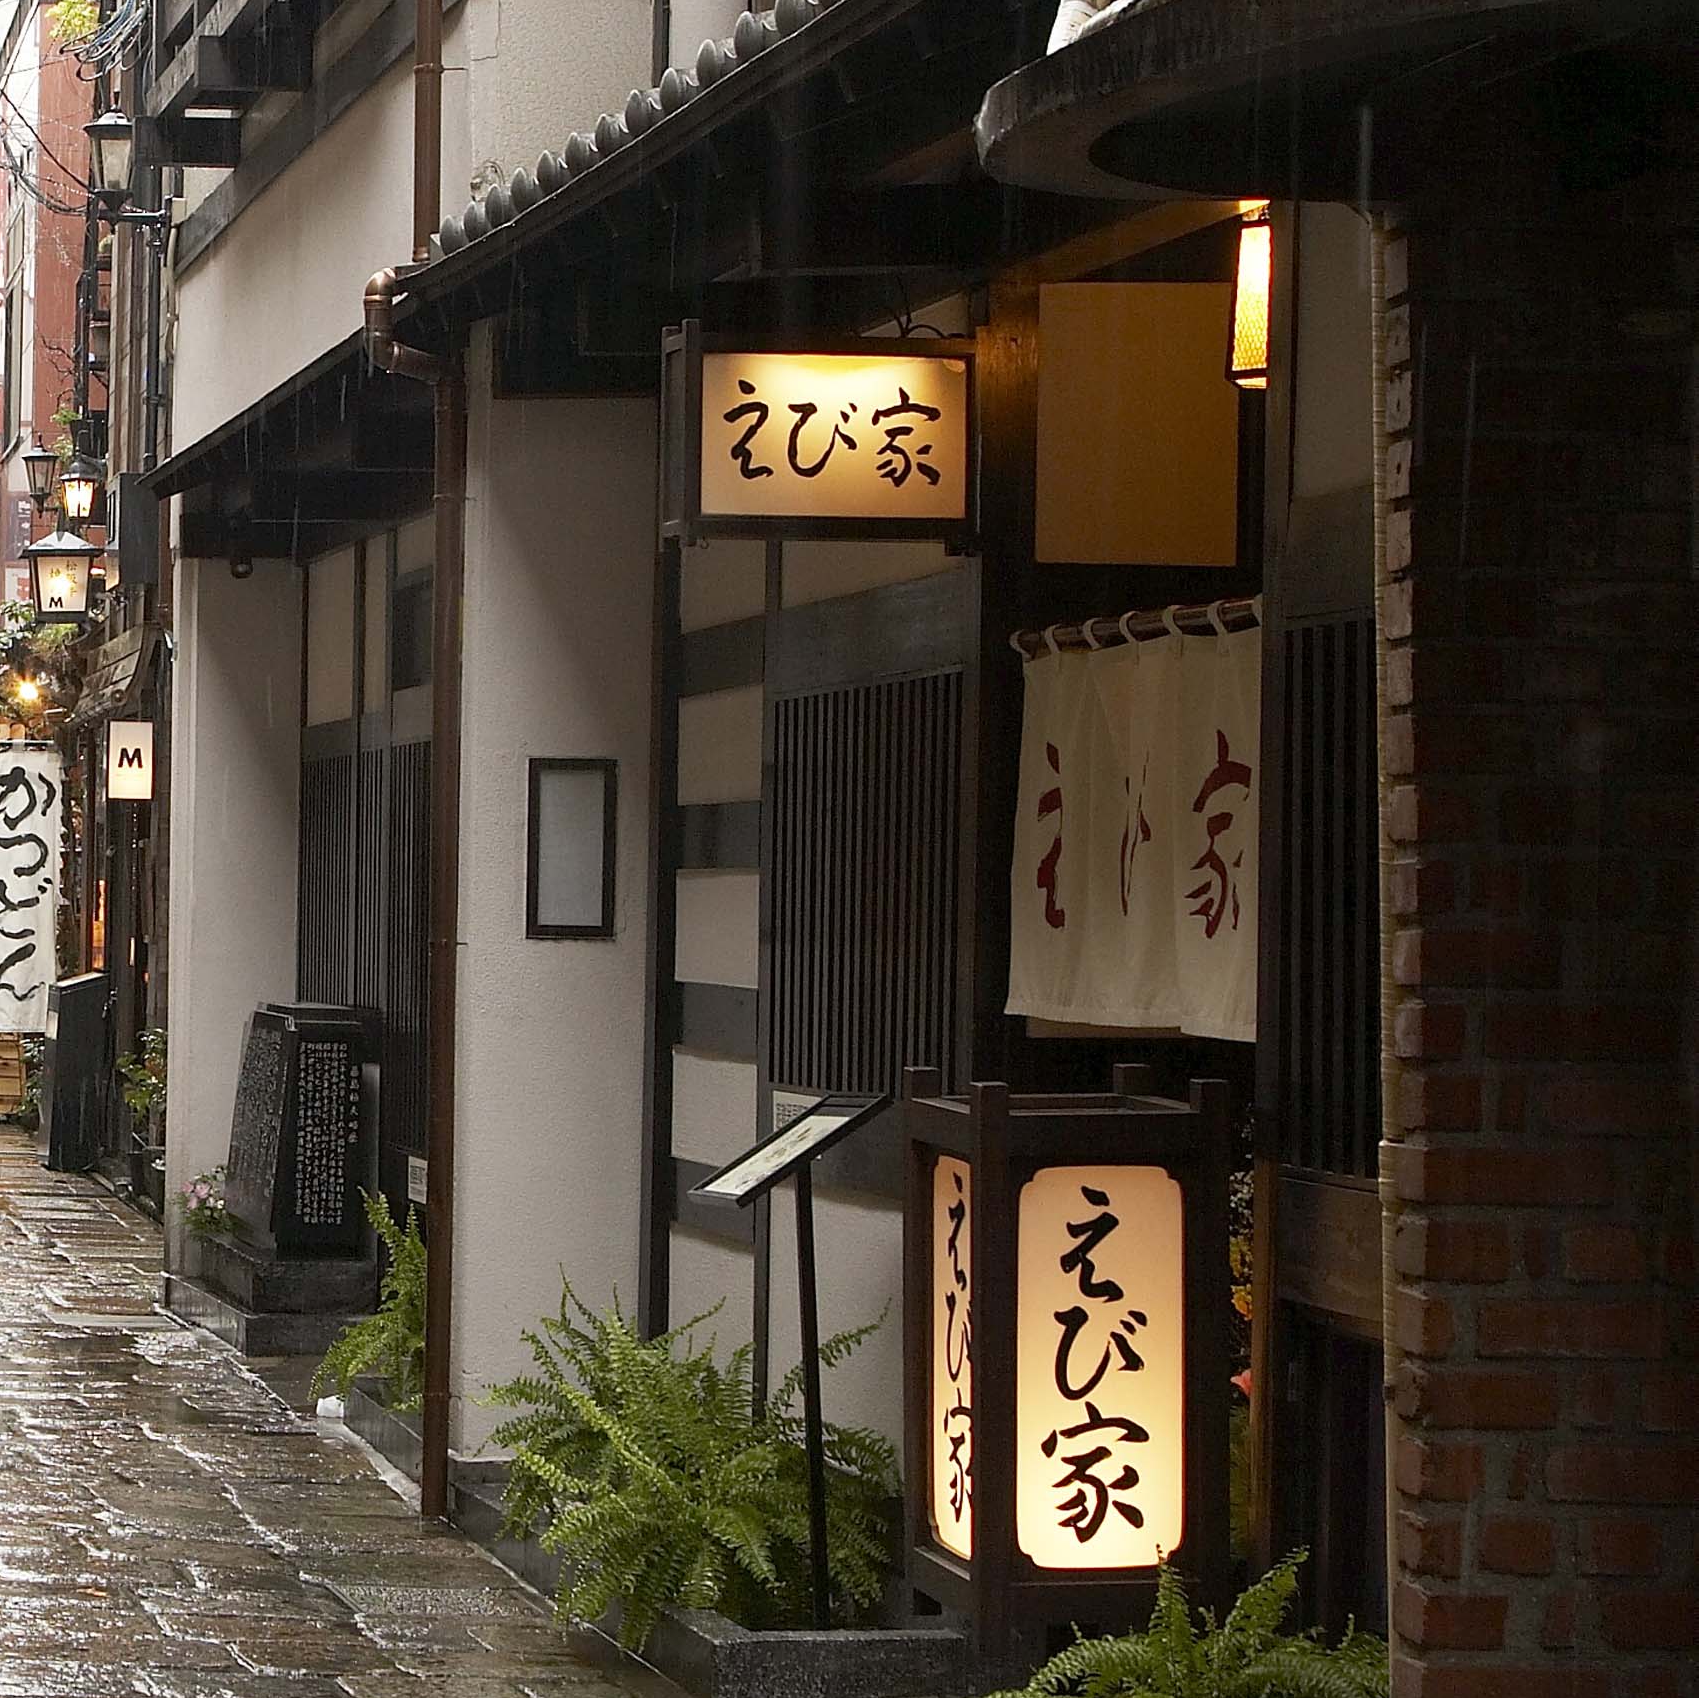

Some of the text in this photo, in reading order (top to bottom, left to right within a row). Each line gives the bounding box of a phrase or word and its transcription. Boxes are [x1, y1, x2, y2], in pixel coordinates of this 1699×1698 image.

[722, 379, 943, 489] えび家
[49, 596, 64, 609] M
[117, 747, 144, 769] M
[1040, 1184, 1151, 1544] えび家
